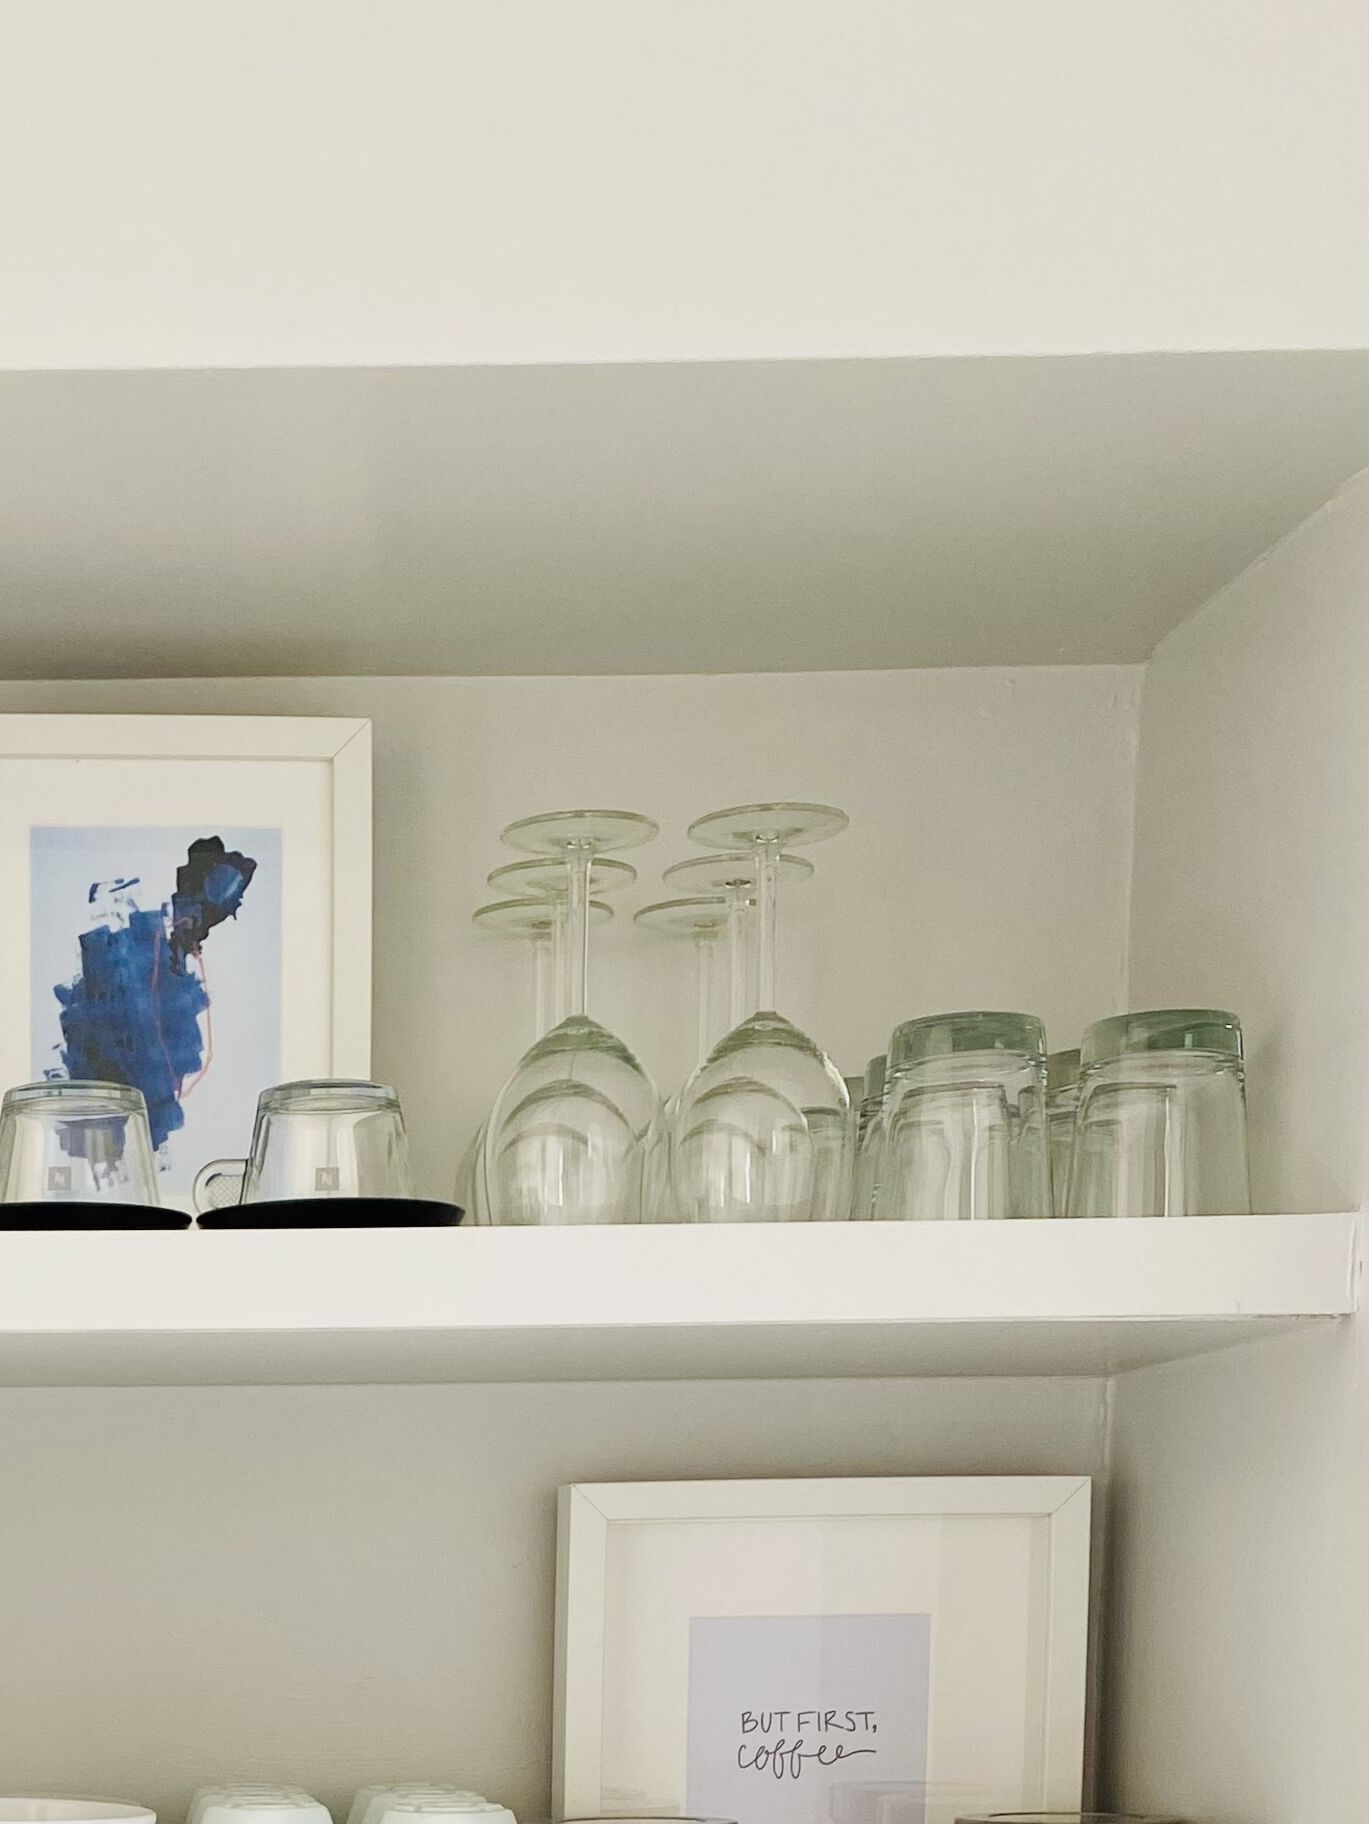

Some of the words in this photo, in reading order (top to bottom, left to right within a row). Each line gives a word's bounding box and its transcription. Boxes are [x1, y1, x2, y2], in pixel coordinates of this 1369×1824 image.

[741, 1711, 791, 1734] BUT
[797, 1710, 877, 1734] FIRST,
[737, 1739, 877, 1779] coffee
